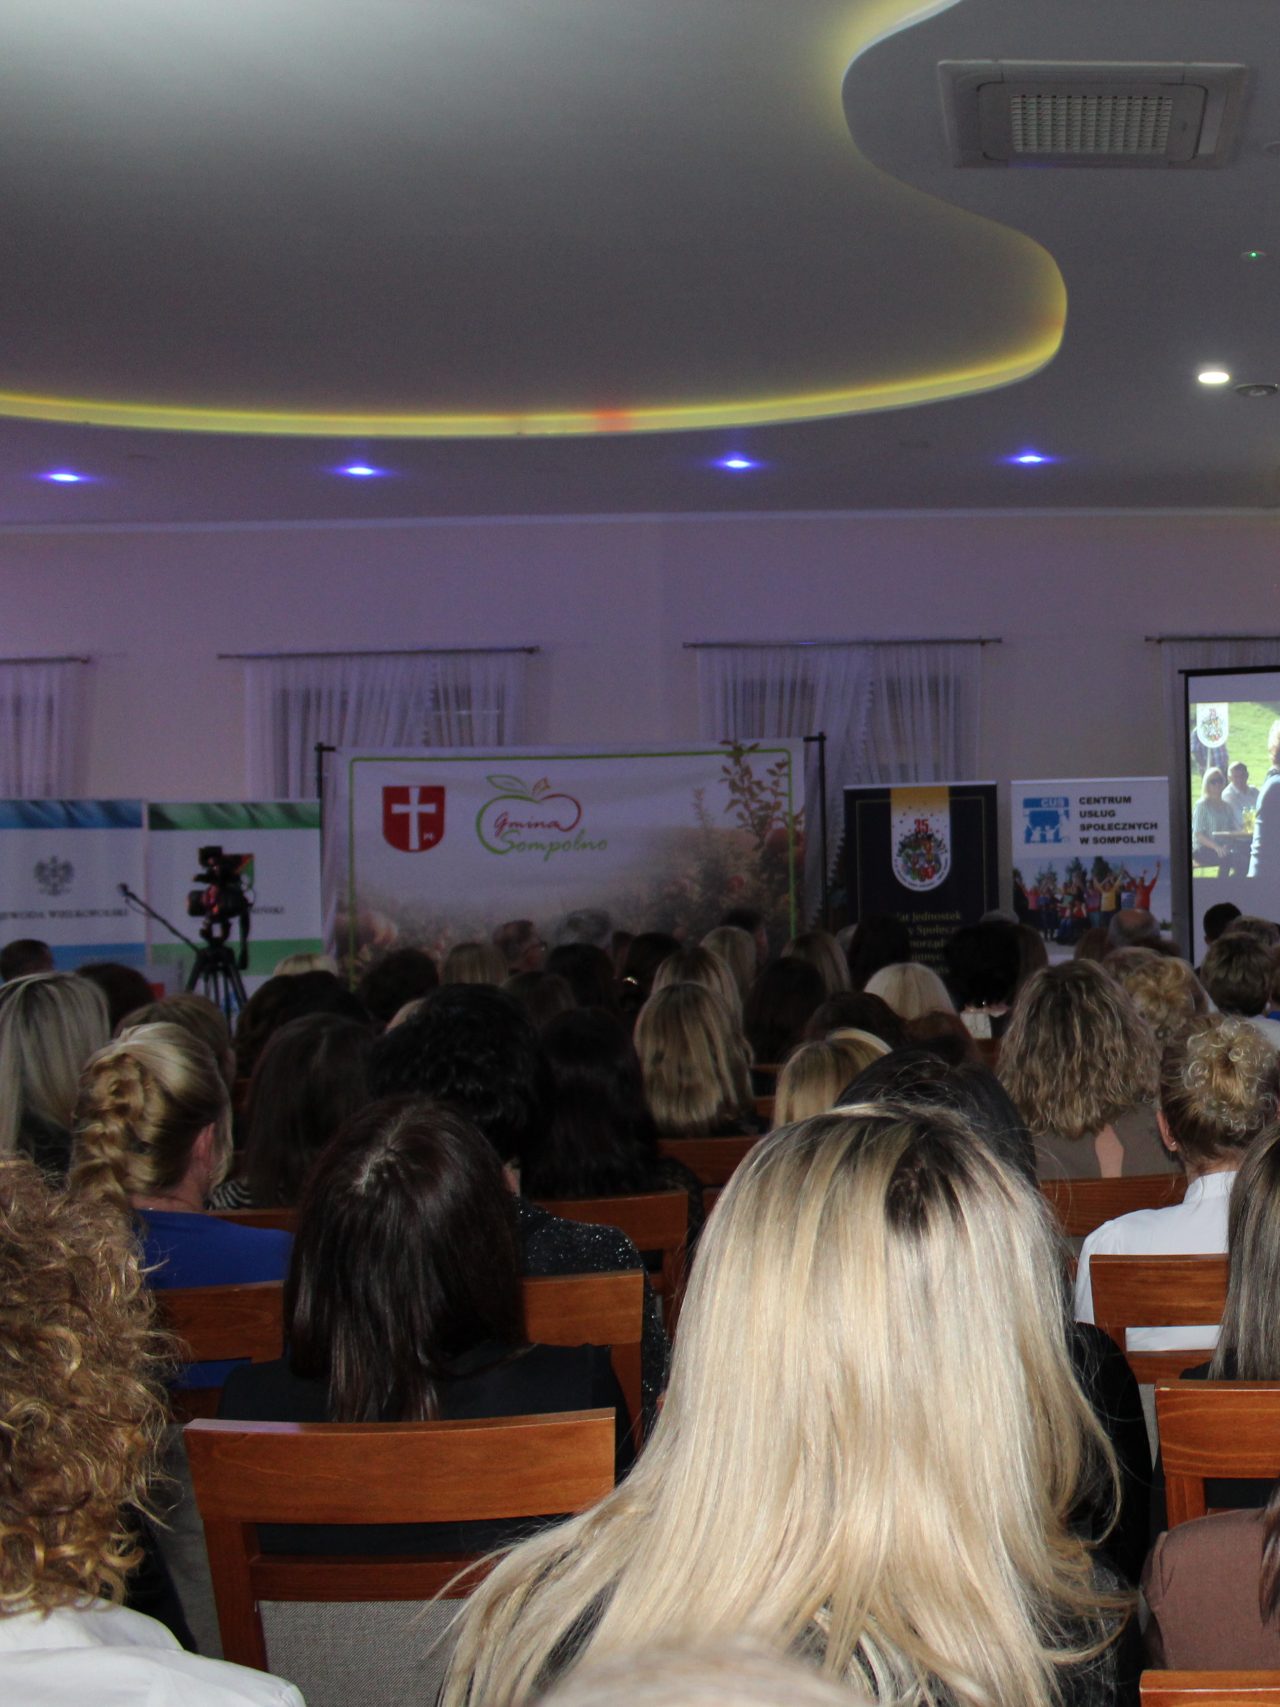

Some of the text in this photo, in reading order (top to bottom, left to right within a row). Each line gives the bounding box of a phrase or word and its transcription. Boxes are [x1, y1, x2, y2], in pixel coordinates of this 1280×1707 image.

[1079, 796, 1132, 805] CENTRUM
[1079, 810, 1116, 818] USŁUG
[494, 812, 560, 838] Gmina
[1079, 822, 1158, 832] SPOŁECZNYCH
[1079, 835, 1155, 845] W SOMPOLNIE
[500, 829, 608, 862] Sompolno
